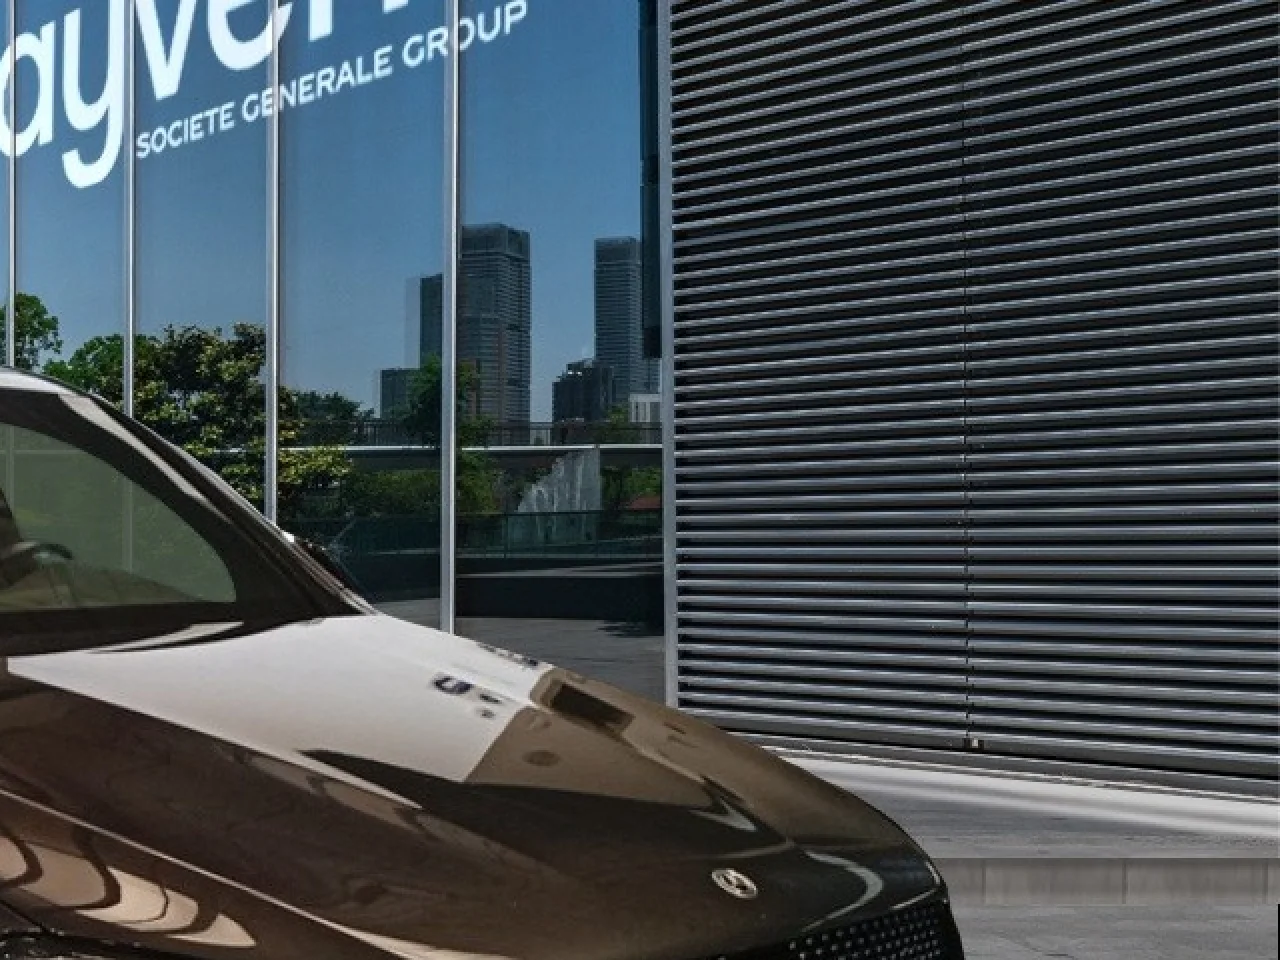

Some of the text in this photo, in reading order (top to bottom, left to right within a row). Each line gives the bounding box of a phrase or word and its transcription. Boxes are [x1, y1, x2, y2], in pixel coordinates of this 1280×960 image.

[135, 0, 528, 159] SOCIETE GENERALE GROUP
